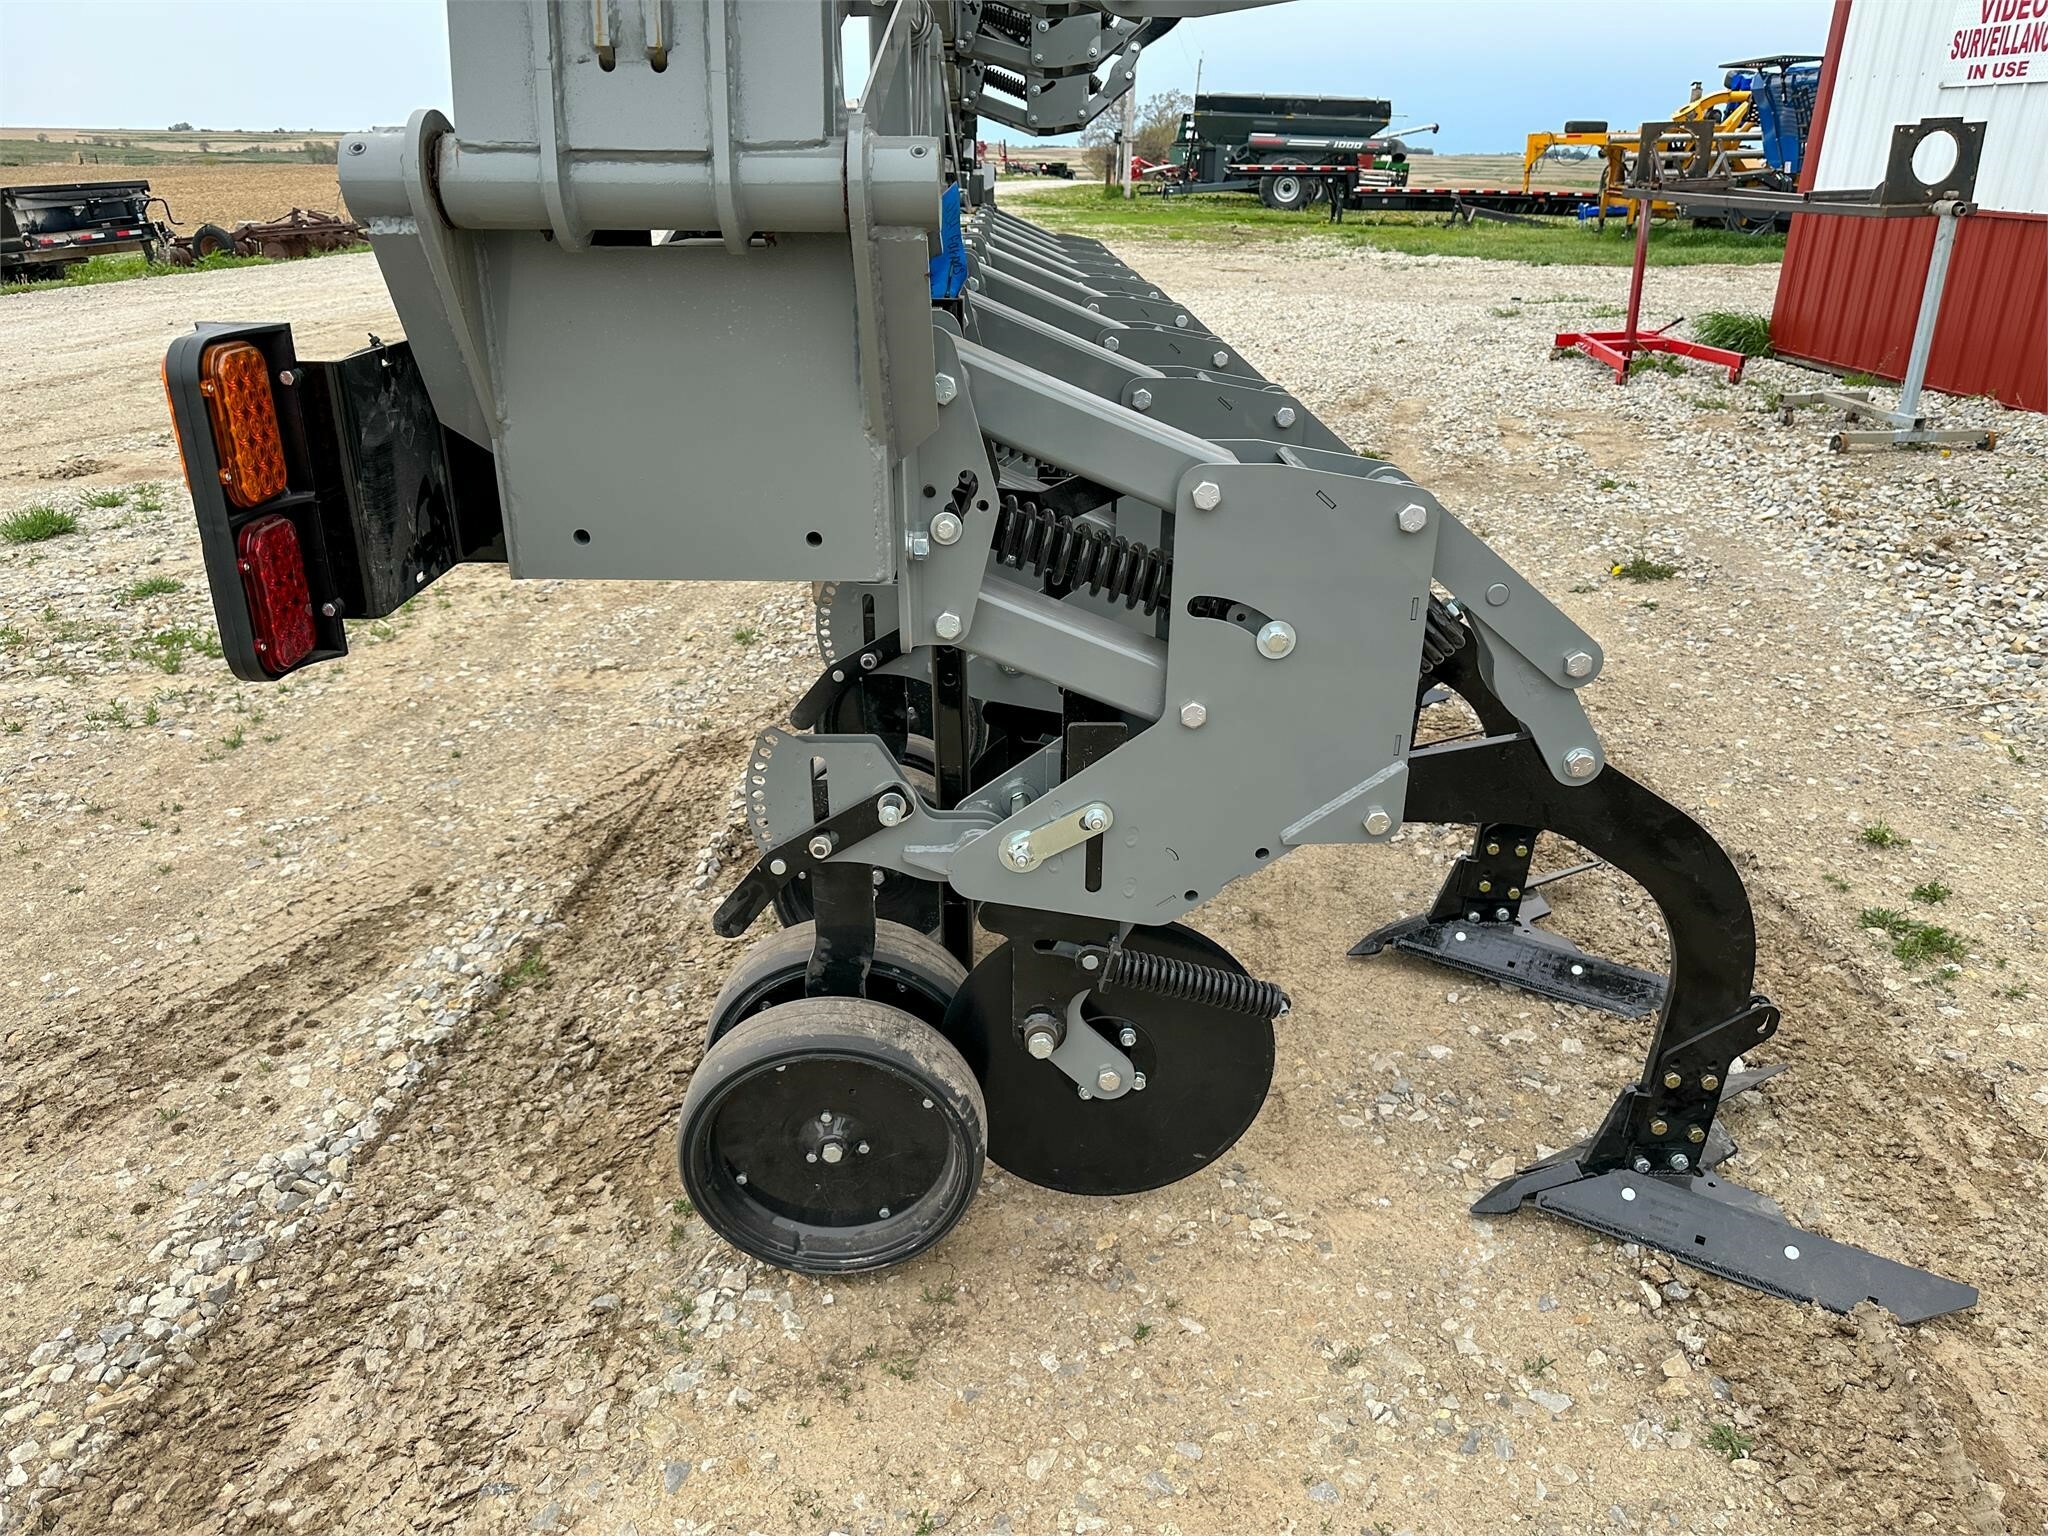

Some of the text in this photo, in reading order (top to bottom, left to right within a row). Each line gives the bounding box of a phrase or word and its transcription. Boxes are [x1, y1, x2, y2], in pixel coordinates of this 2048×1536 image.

[1967, 61, 2029, 80] IN USE
[1333, 140, 1364, 150] 1000
